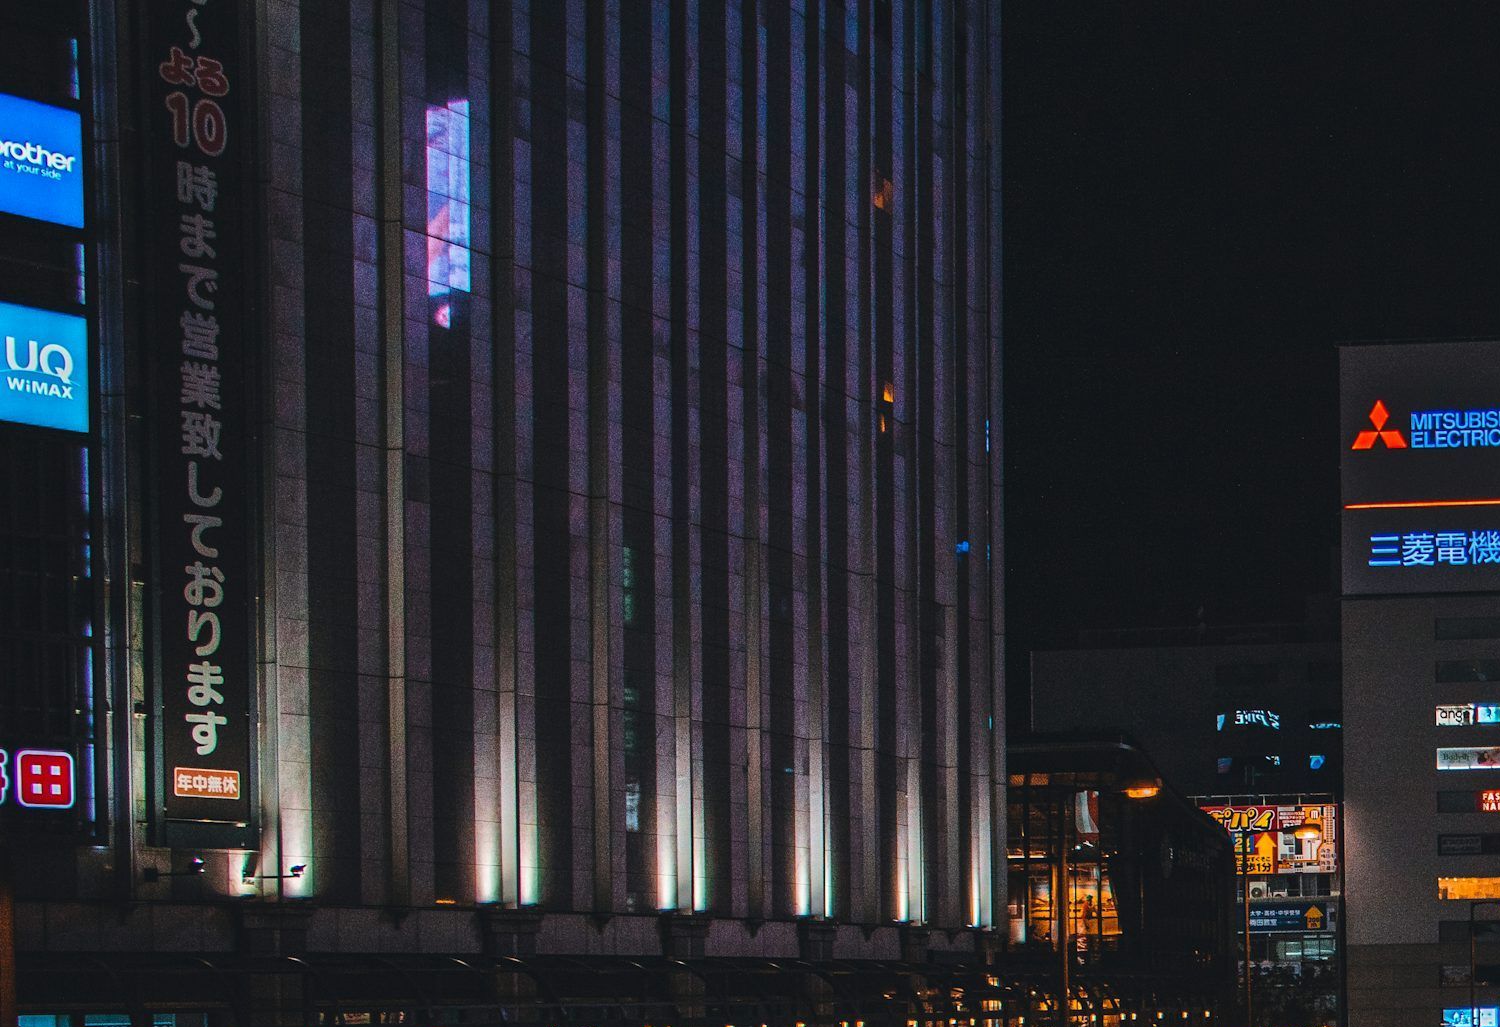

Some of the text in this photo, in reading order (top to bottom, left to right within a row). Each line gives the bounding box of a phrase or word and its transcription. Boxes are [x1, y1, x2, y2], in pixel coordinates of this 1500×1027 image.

[3, 159, 62, 181] at your side
[5, 335, 75, 384] UQ
[7, 376, 73, 400] WiMAX
[176, 773, 238, 795] 年中無休
